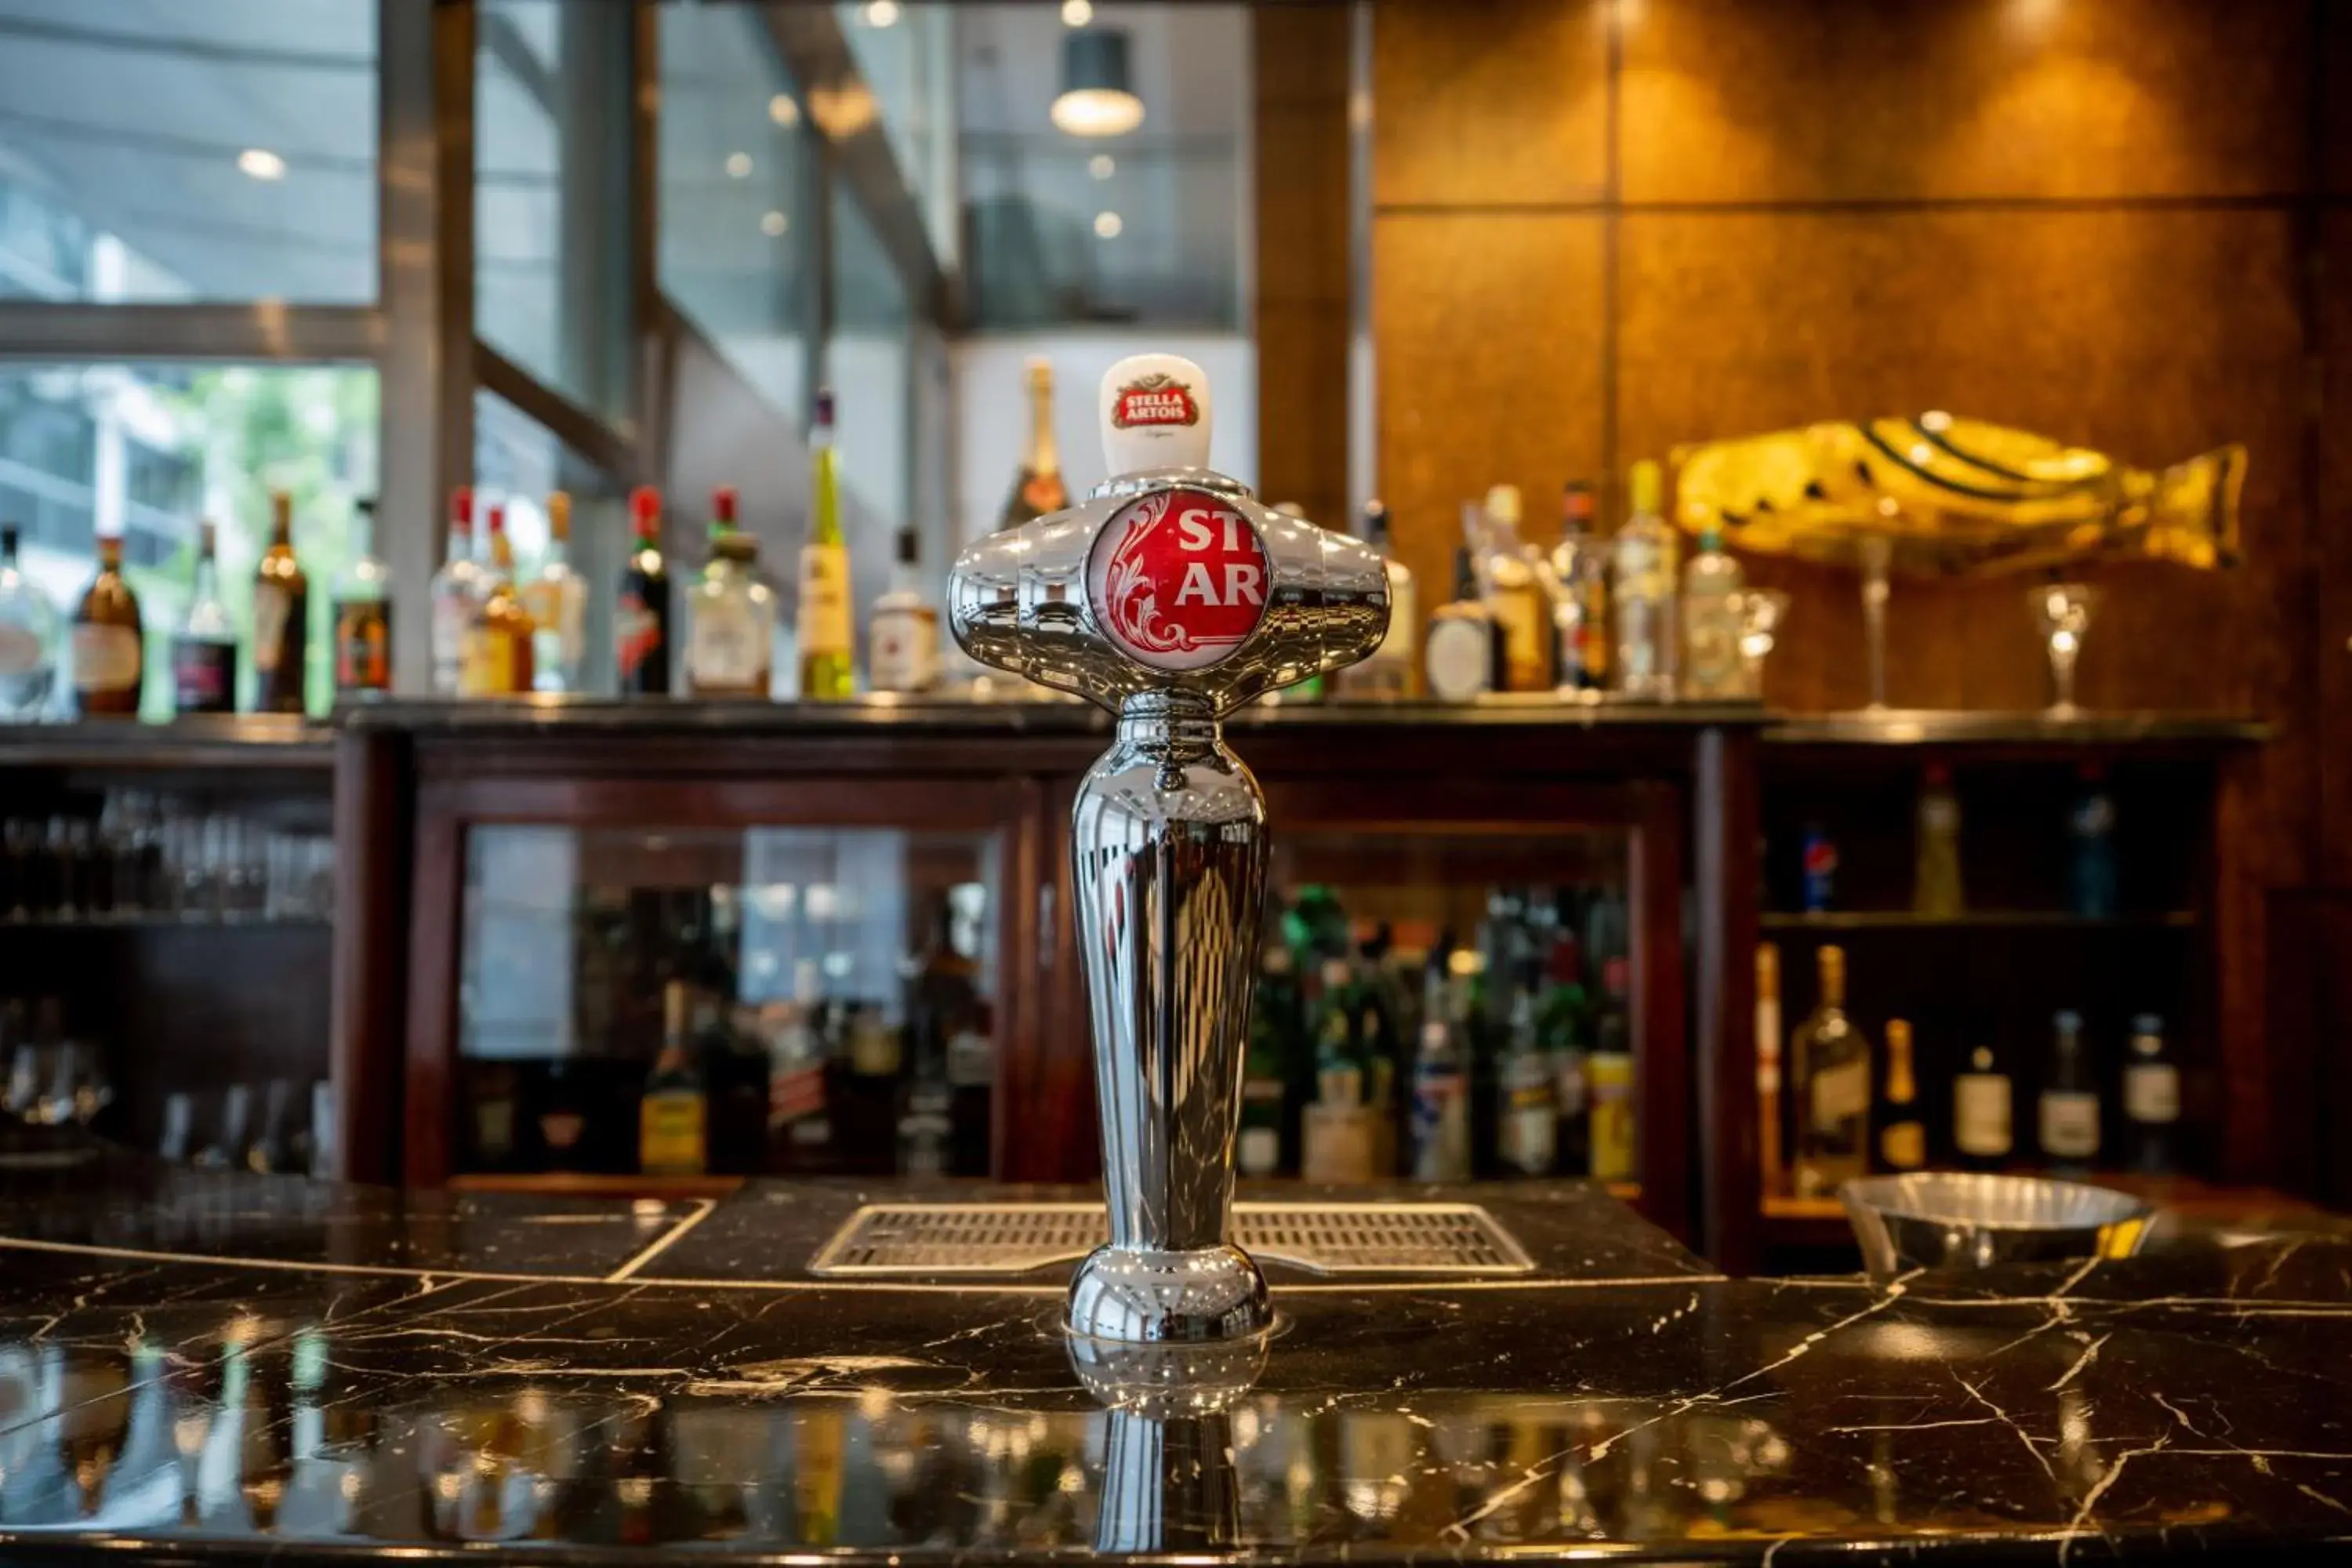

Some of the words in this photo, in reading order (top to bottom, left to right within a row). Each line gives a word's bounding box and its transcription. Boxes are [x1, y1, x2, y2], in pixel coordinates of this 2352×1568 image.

[1126, 394, 1183, 407] STELLA
[1126, 407, 1185, 419] ARTOIS
[1178, 509, 1261, 553] ST
[1174, 562, 1264, 606] AR
